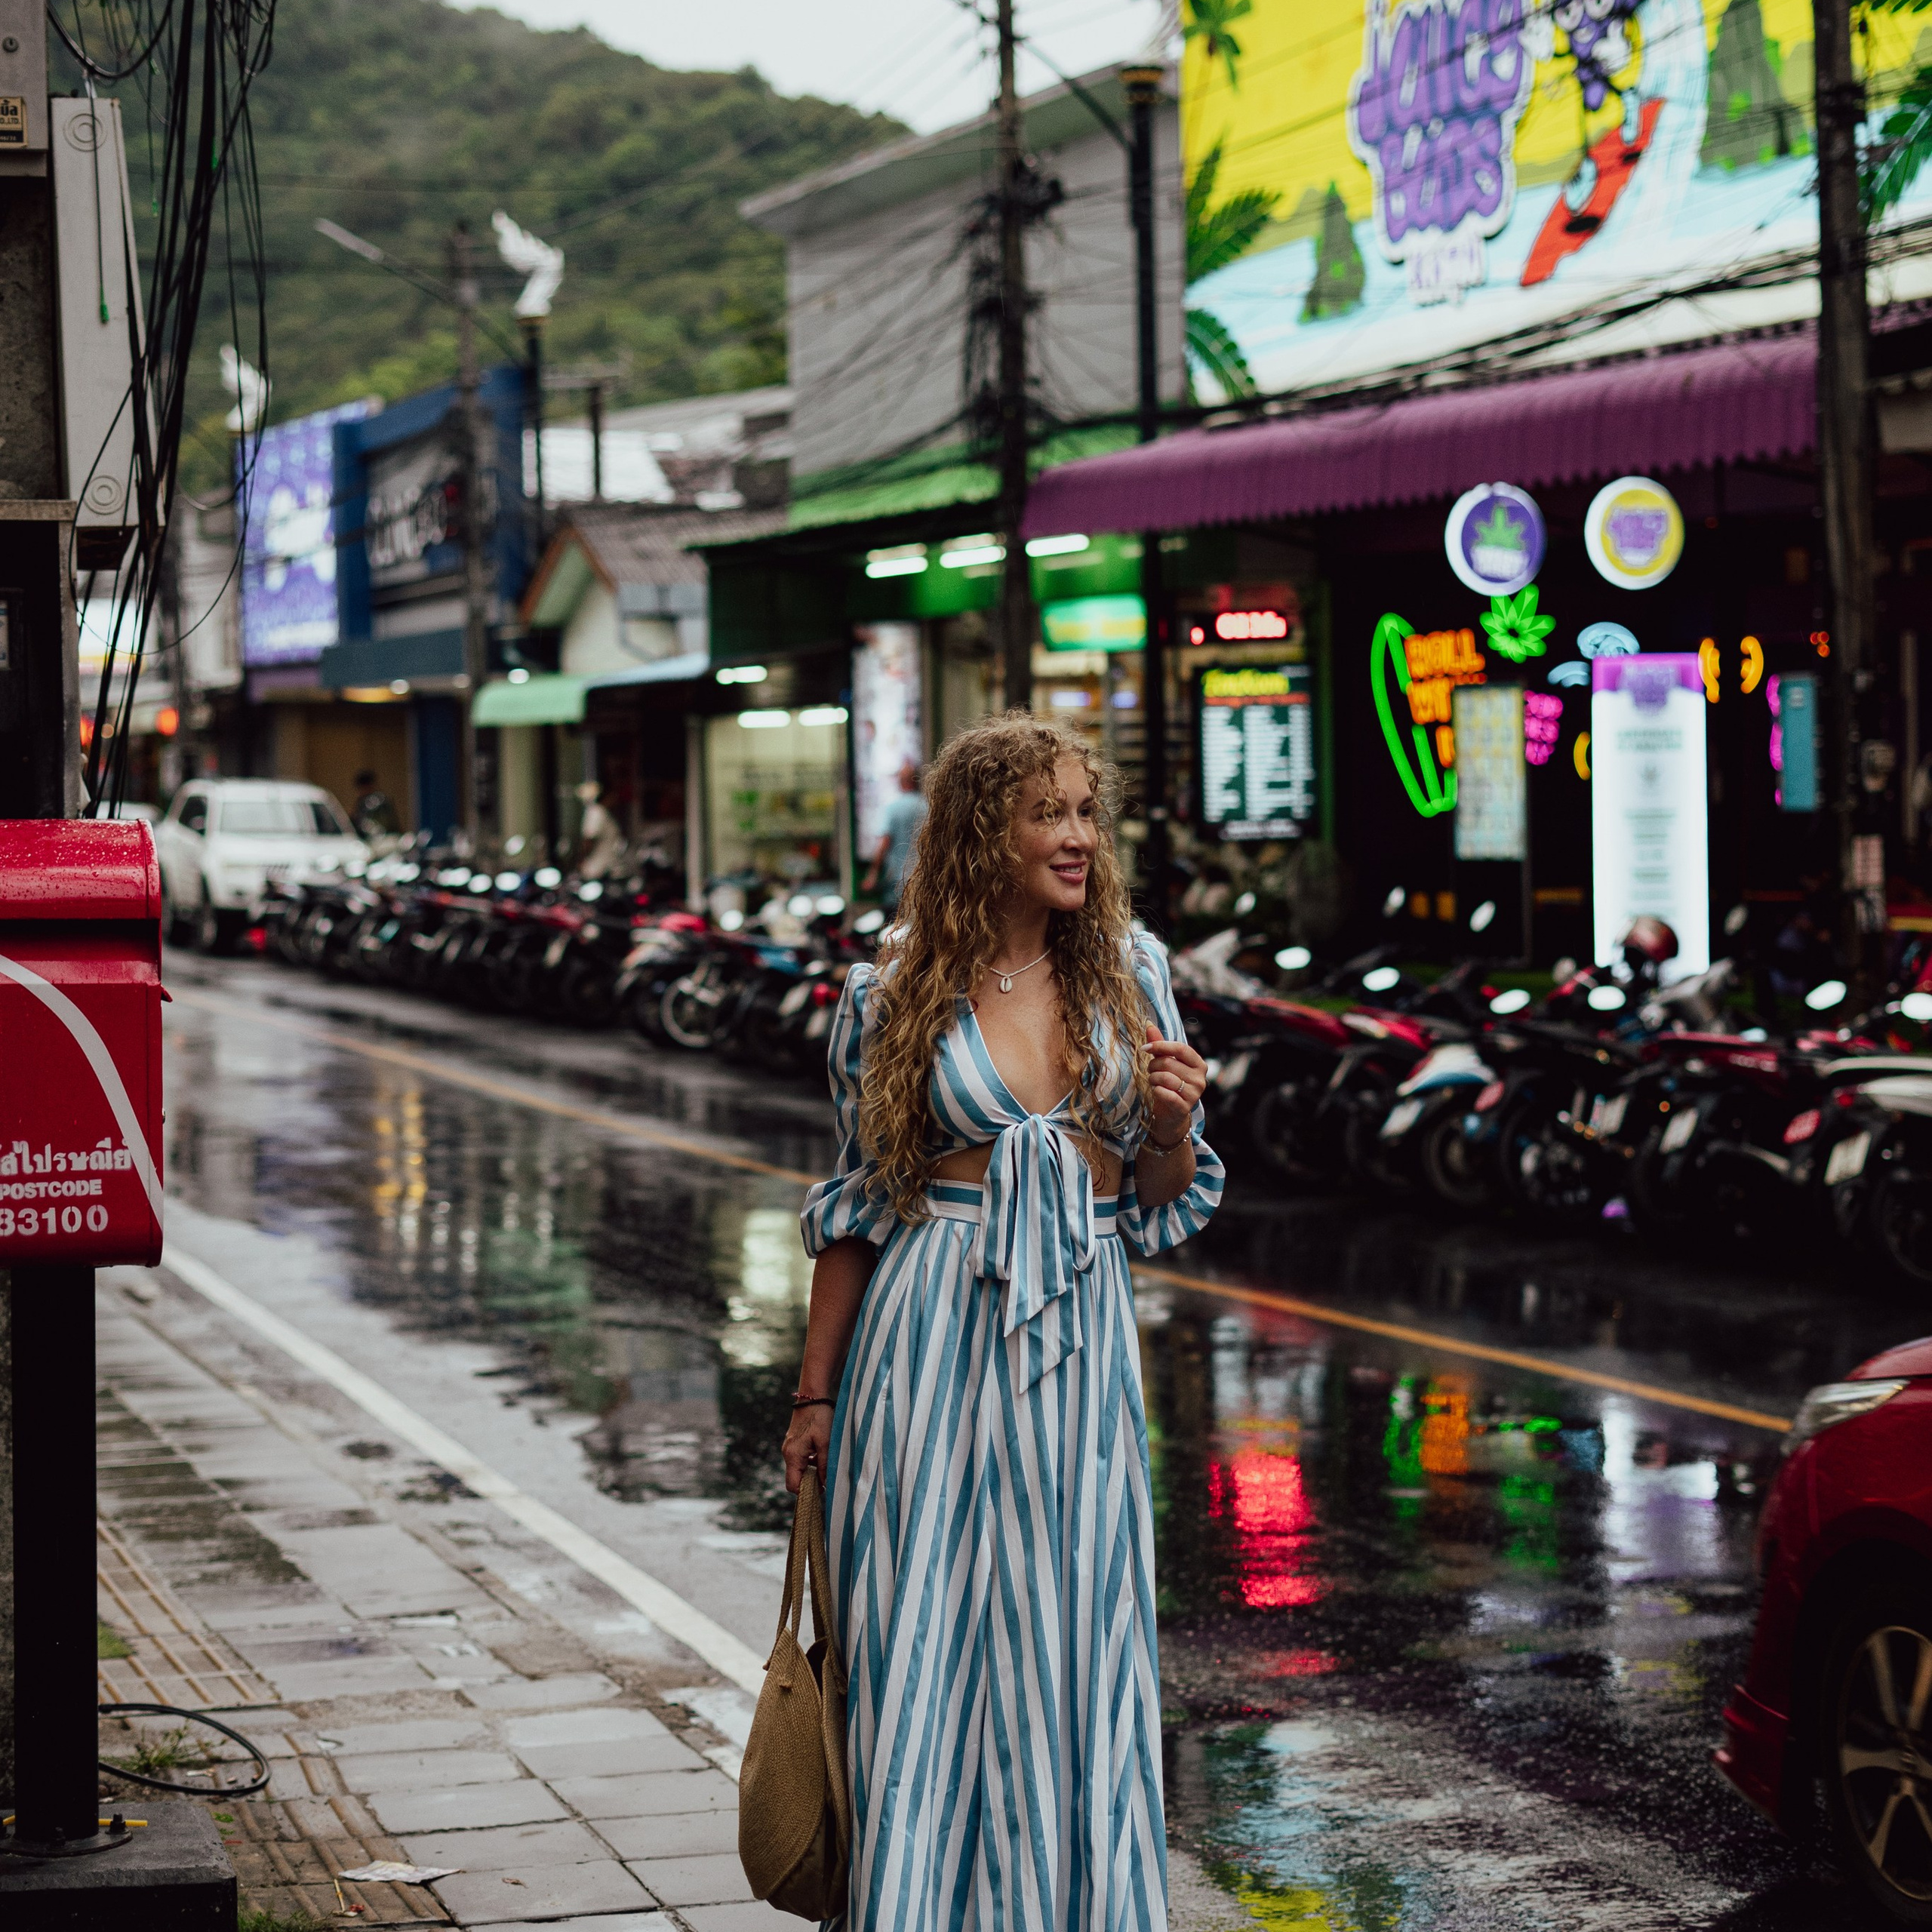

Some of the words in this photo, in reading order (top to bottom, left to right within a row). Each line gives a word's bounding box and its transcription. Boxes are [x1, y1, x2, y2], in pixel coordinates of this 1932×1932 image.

[0, 1137, 133, 1176] สไปรษณีย์
[0, 1178, 103, 1201] POSTCODE
[0, 1204, 109, 1237] 83100
